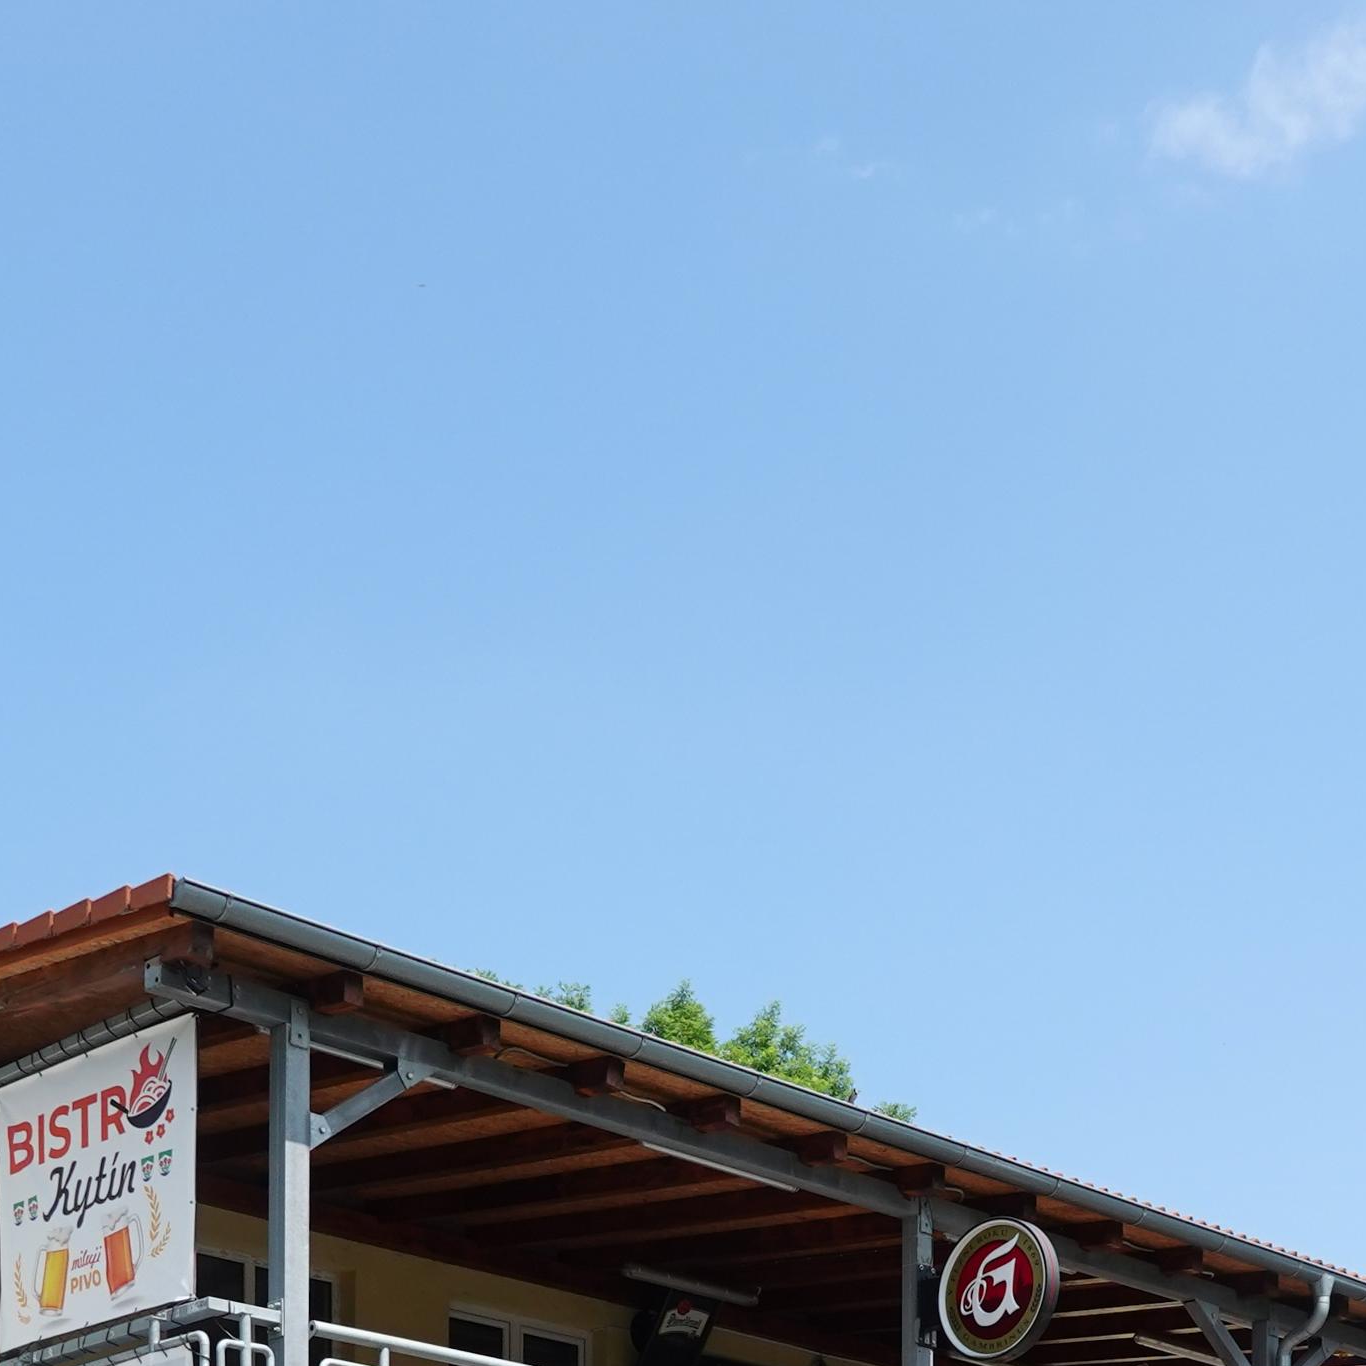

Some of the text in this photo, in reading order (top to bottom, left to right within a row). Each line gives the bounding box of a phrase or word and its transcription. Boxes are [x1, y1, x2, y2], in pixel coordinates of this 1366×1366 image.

[43, 1151, 137, 1228] Kytín
[71, 1245, 102, 1271] miluji
[70, 1270, 102, 1296] PIVO
